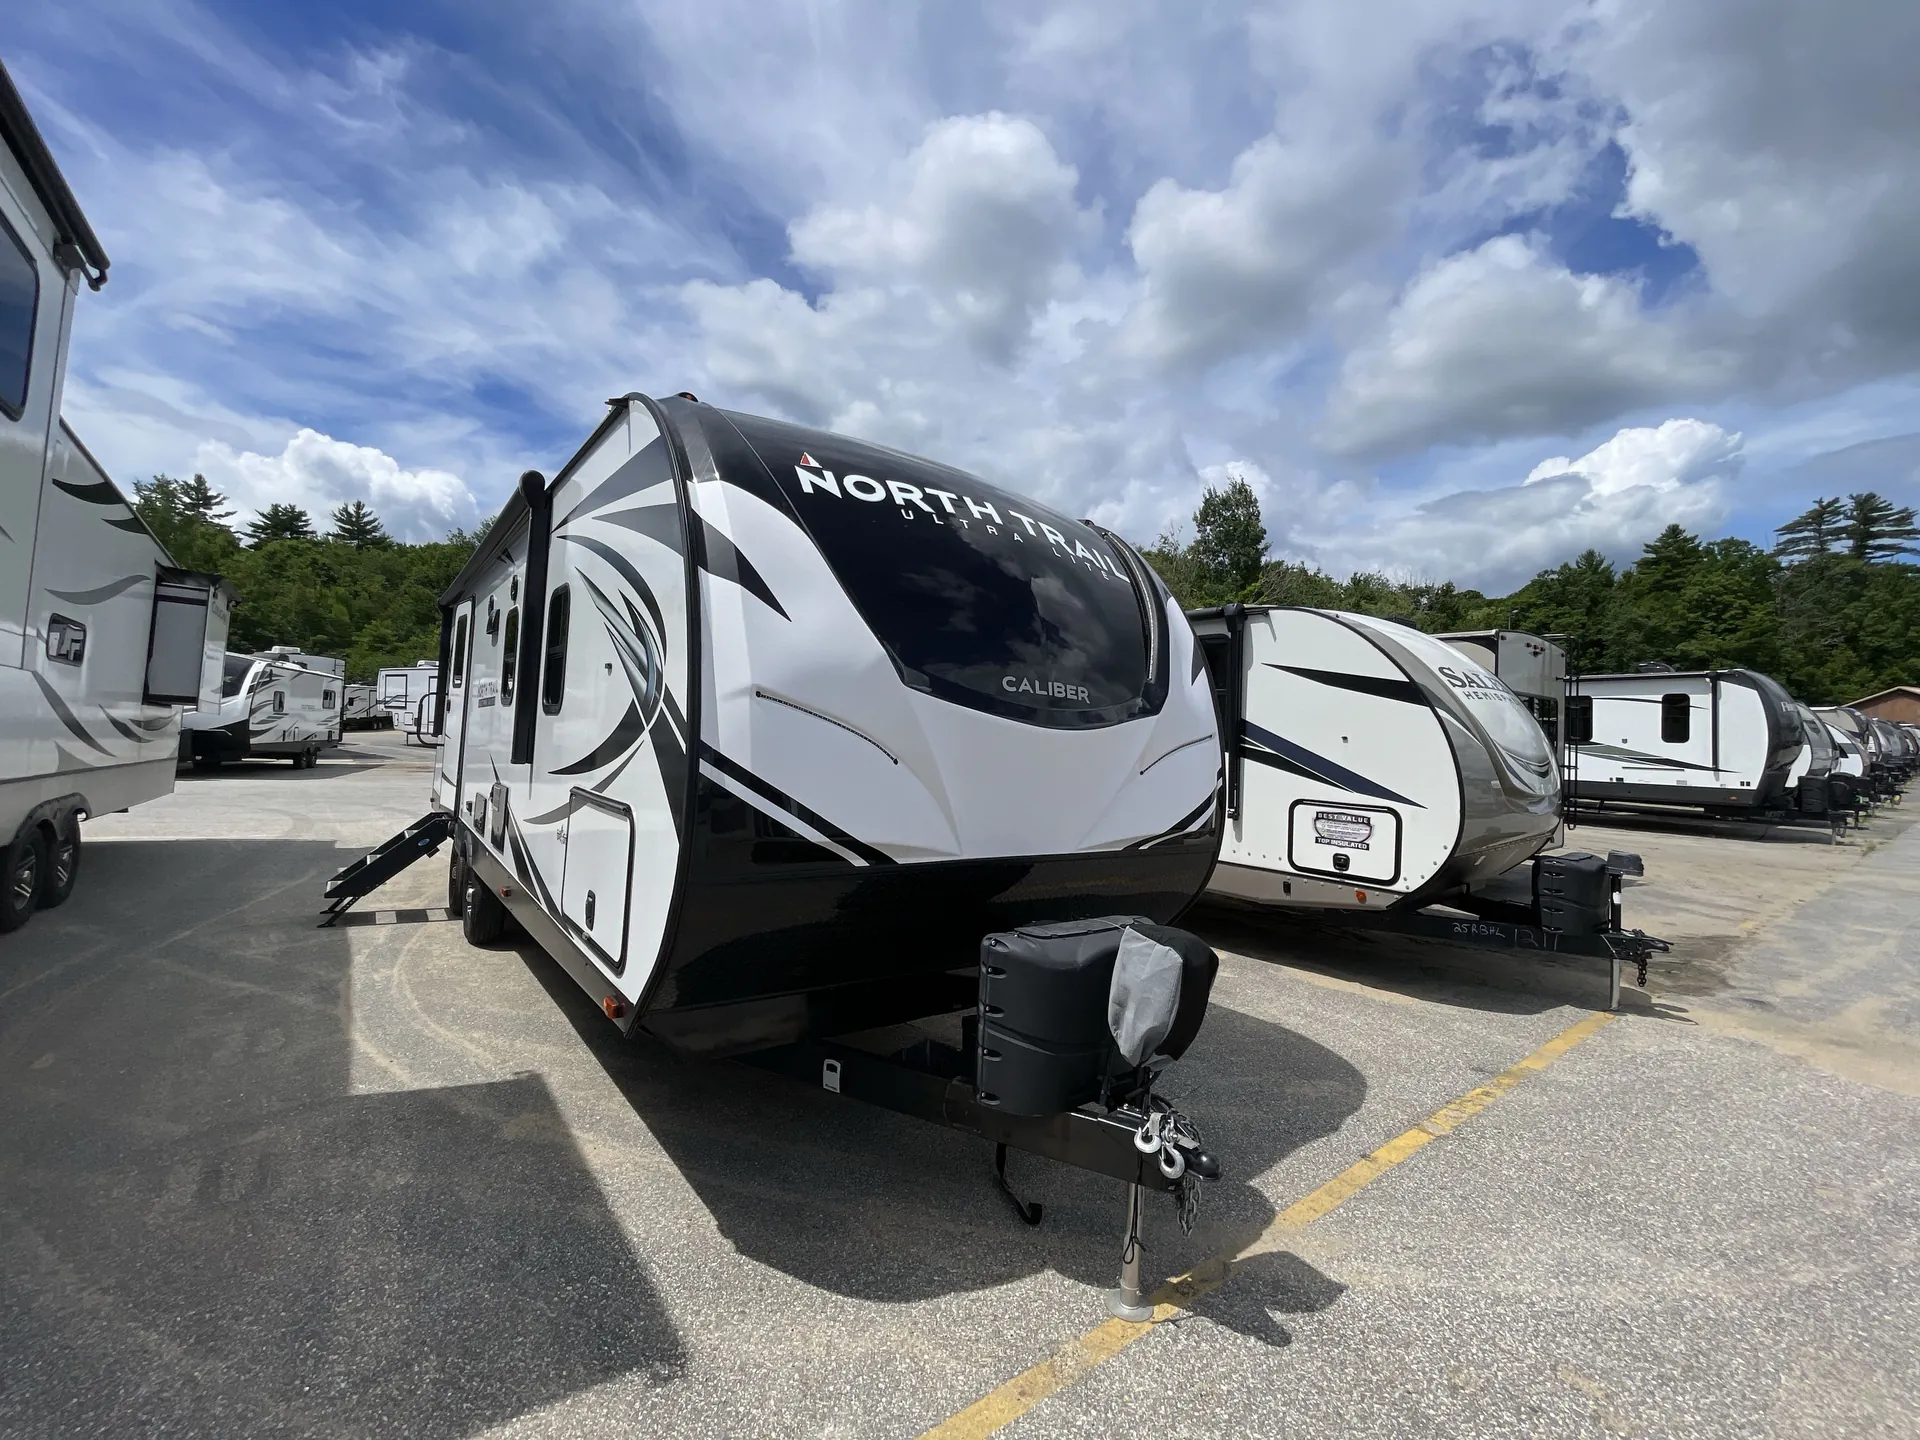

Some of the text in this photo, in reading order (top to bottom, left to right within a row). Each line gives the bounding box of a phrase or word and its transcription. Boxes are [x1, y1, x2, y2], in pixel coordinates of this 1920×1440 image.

[794, 464, 1131, 584] NORTH TRAIL
[900, 508, 1110, 581] ULTRA LITE
[1002, 675, 1091, 705] CALIBER
[1317, 812, 1369, 824] BEST VALUE
[1330, 839, 1368, 849] INSULATED
